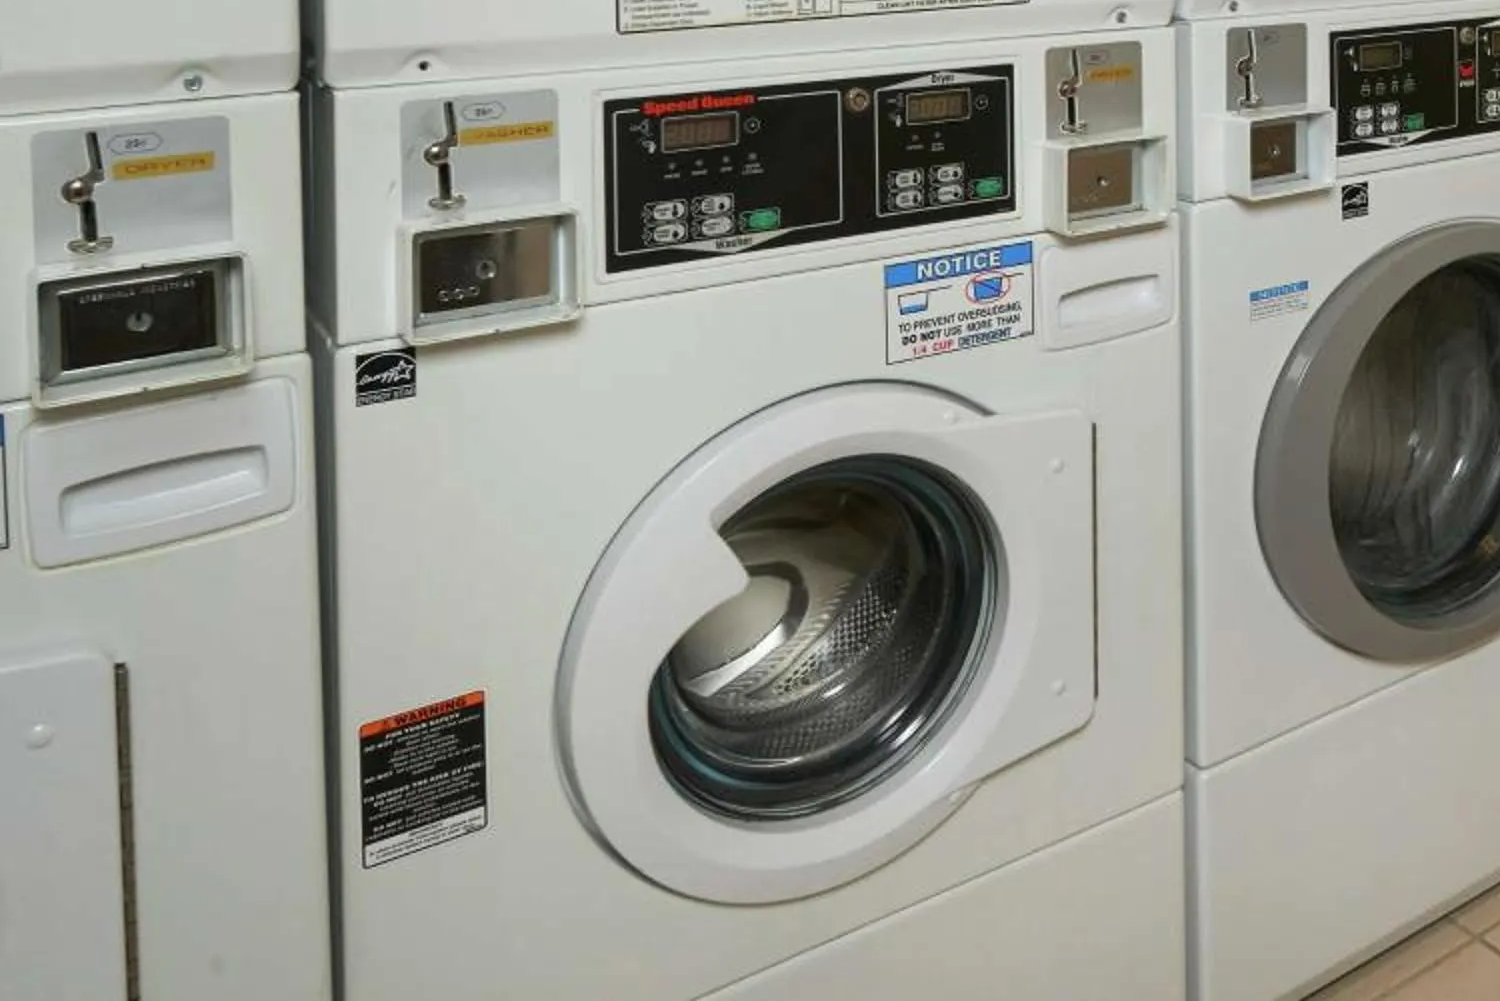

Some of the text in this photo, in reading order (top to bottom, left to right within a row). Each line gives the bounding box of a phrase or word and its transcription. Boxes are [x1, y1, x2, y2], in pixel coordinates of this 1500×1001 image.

[642, 93, 755, 117] Speed Queen
[917, 251, 1001, 280] NOTICE
[899, 322, 912, 334] TO
[914, 313, 956, 330] PREVENT
[902, 313, 1021, 346] DO NOT USE MORE THAN
[932, 338, 954, 352] CUP
[958, 326, 1013, 349] DETERGENT
[394, 697, 466, 726] WARNING
